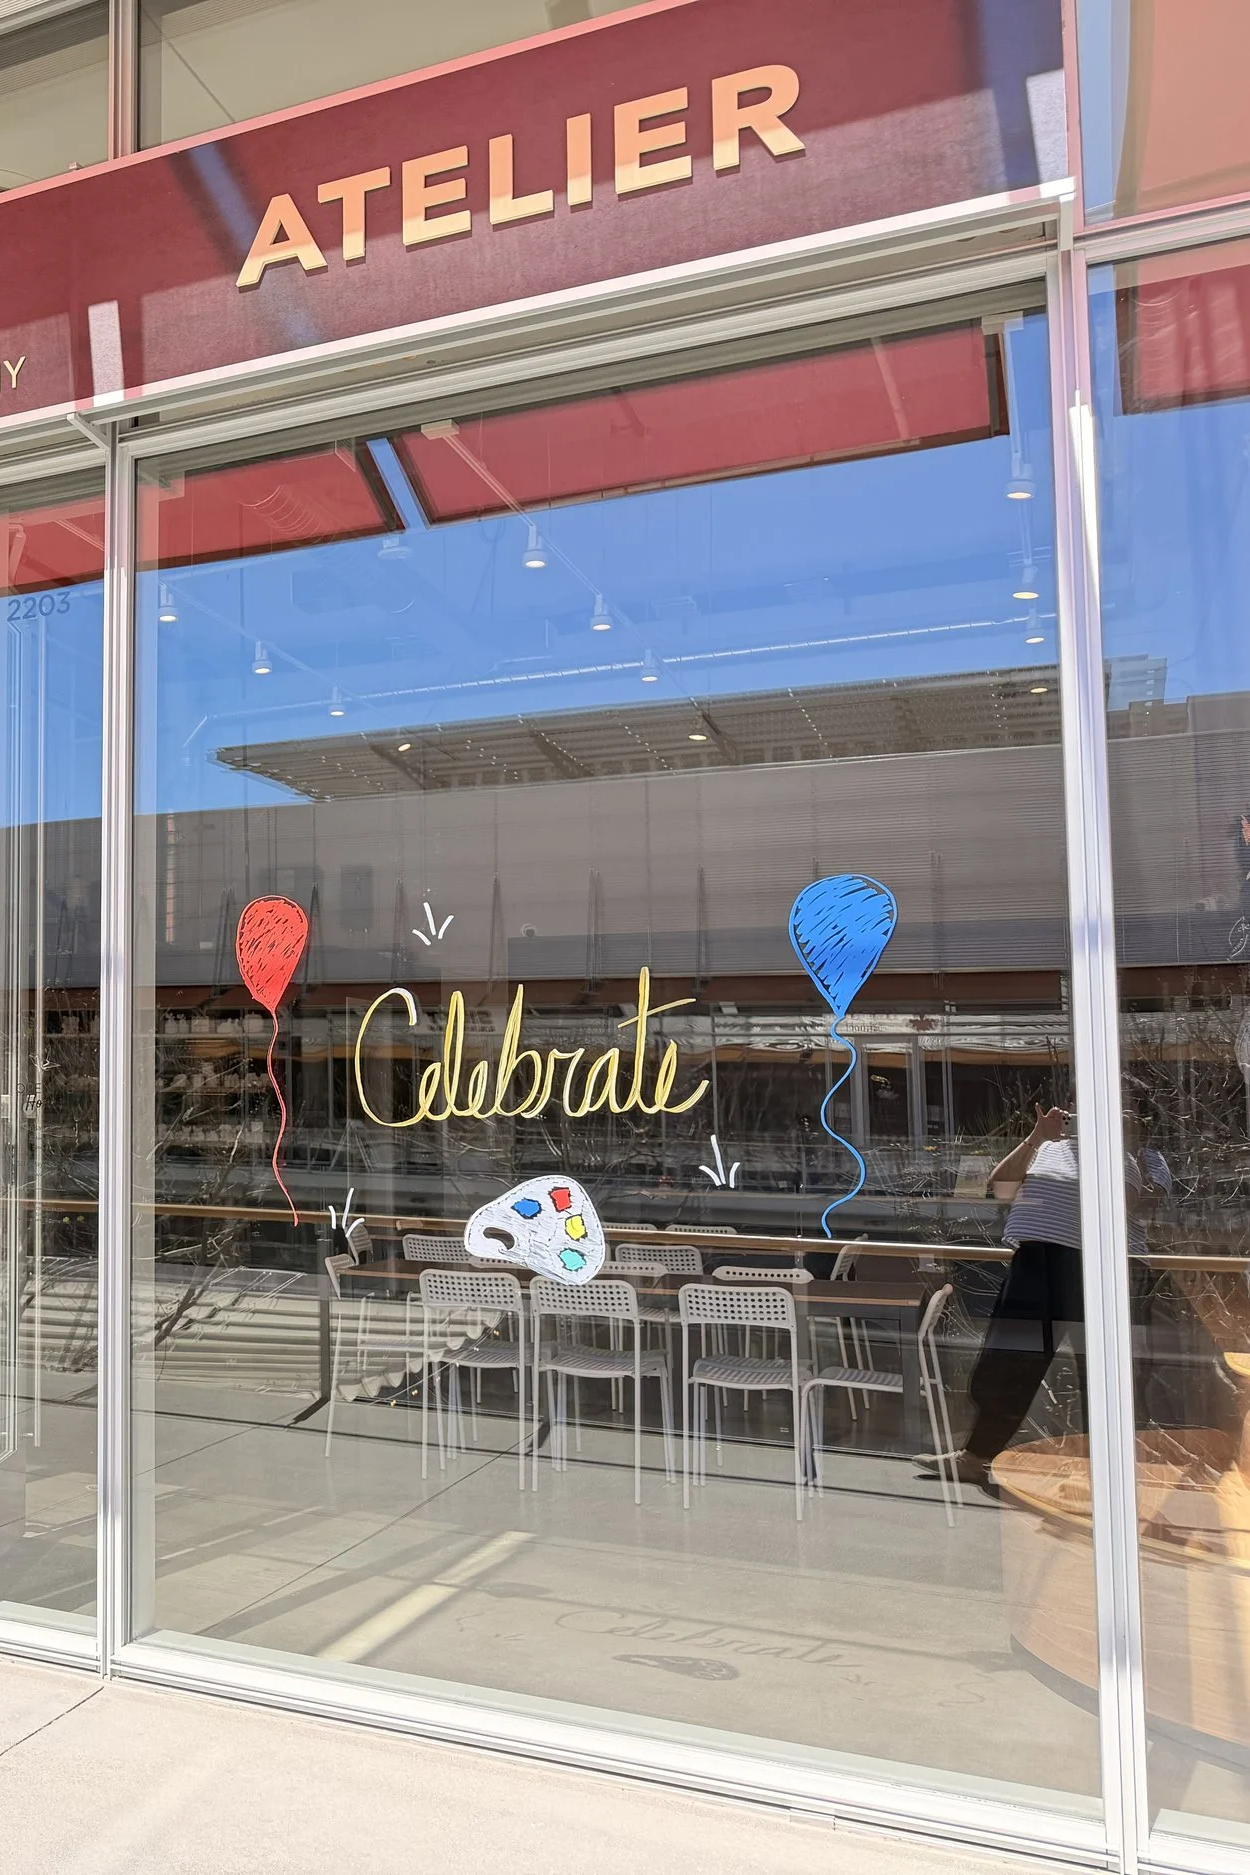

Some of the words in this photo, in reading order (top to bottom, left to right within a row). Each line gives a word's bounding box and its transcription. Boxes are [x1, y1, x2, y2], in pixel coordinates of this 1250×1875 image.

[235, 63, 807, 289] ATELIER
[7, 591, 71, 622] 2203
[354, 965, 710, 1128] Celebrate
